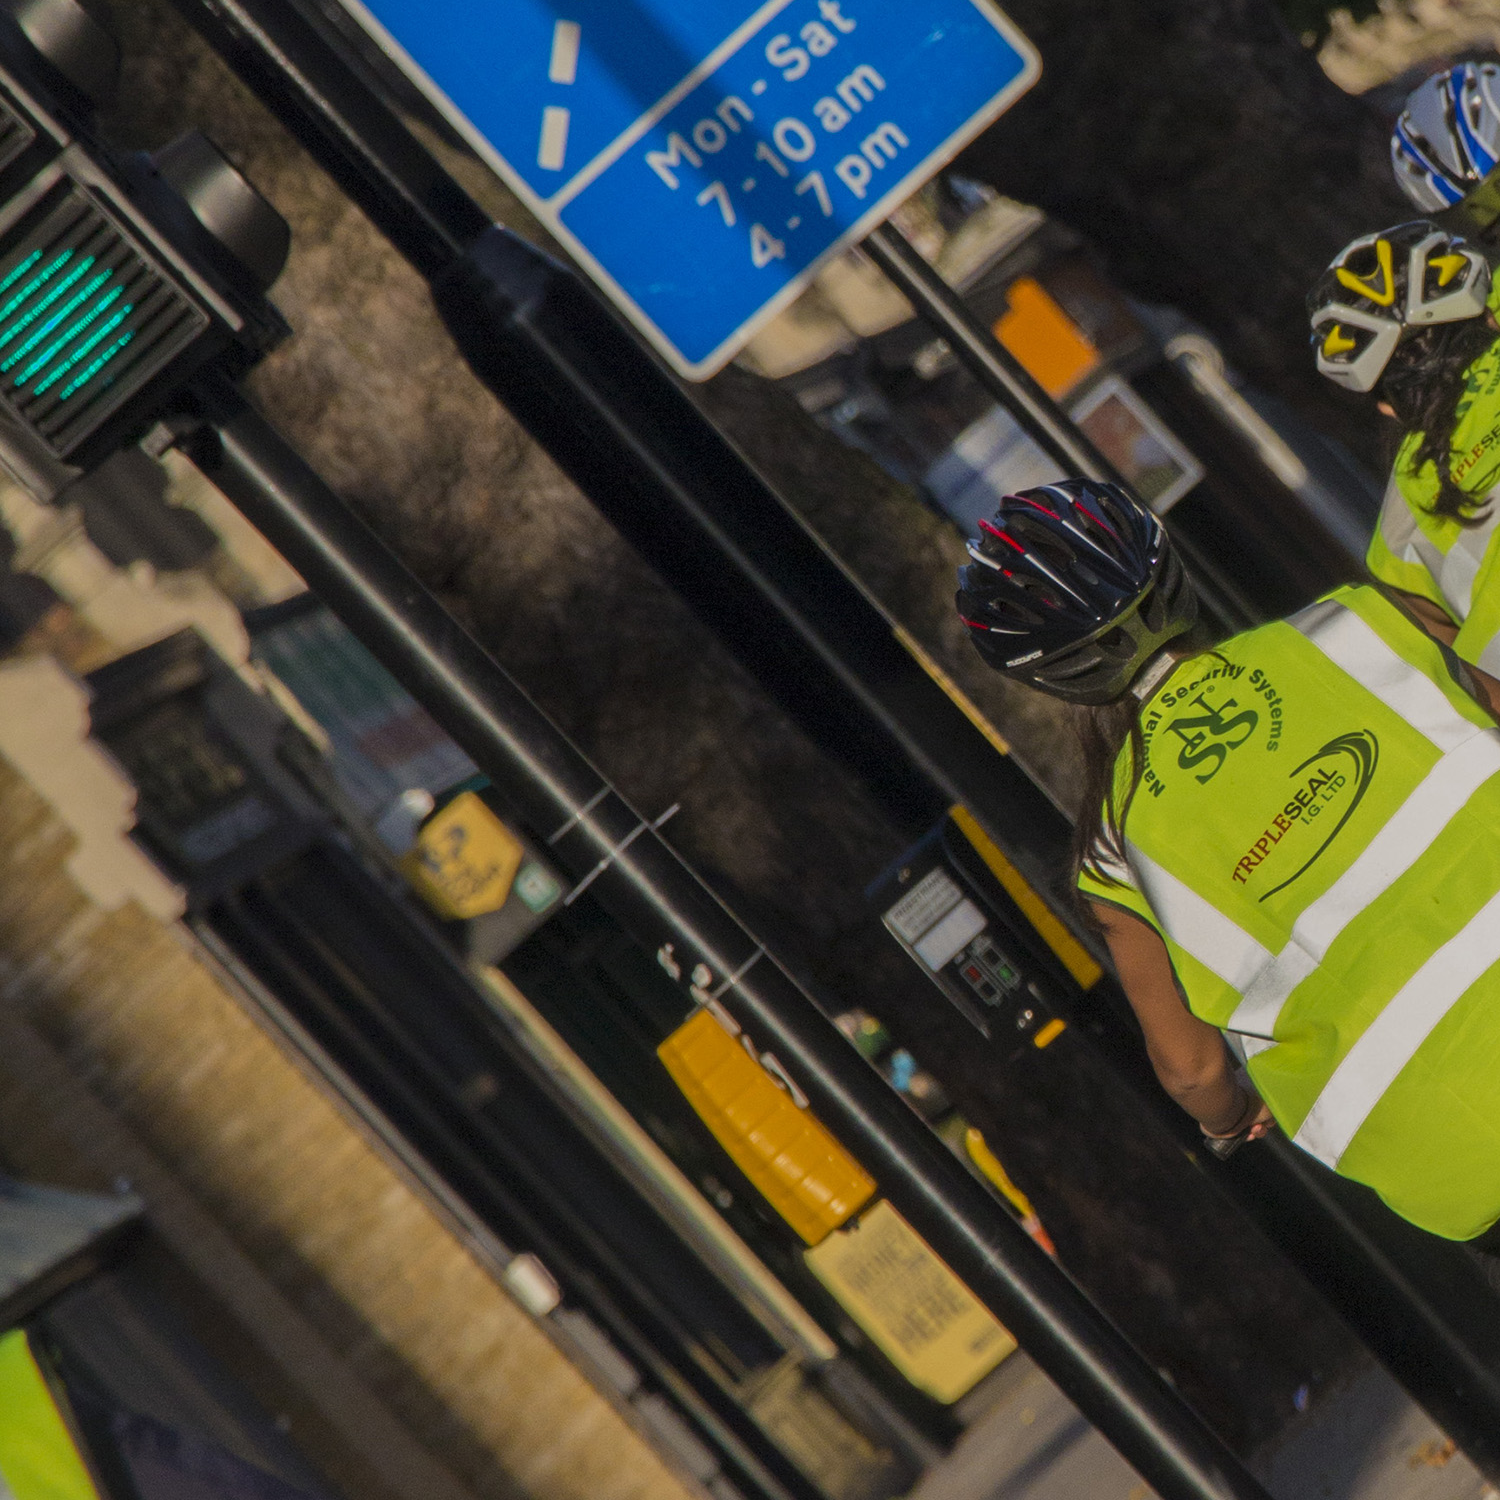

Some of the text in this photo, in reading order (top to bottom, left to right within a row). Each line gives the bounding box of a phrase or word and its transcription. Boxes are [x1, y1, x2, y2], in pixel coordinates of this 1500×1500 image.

[813, 63, 887, 134] am
[645, 95, 754, 190] Mon
[834, 121, 910, 200] pm
[1249, 668, 1284, 752] Systems
[1231, 768, 1339, 886] TRIPLESEAL
[1300, 775, 1346, 826] I.G. LTD
